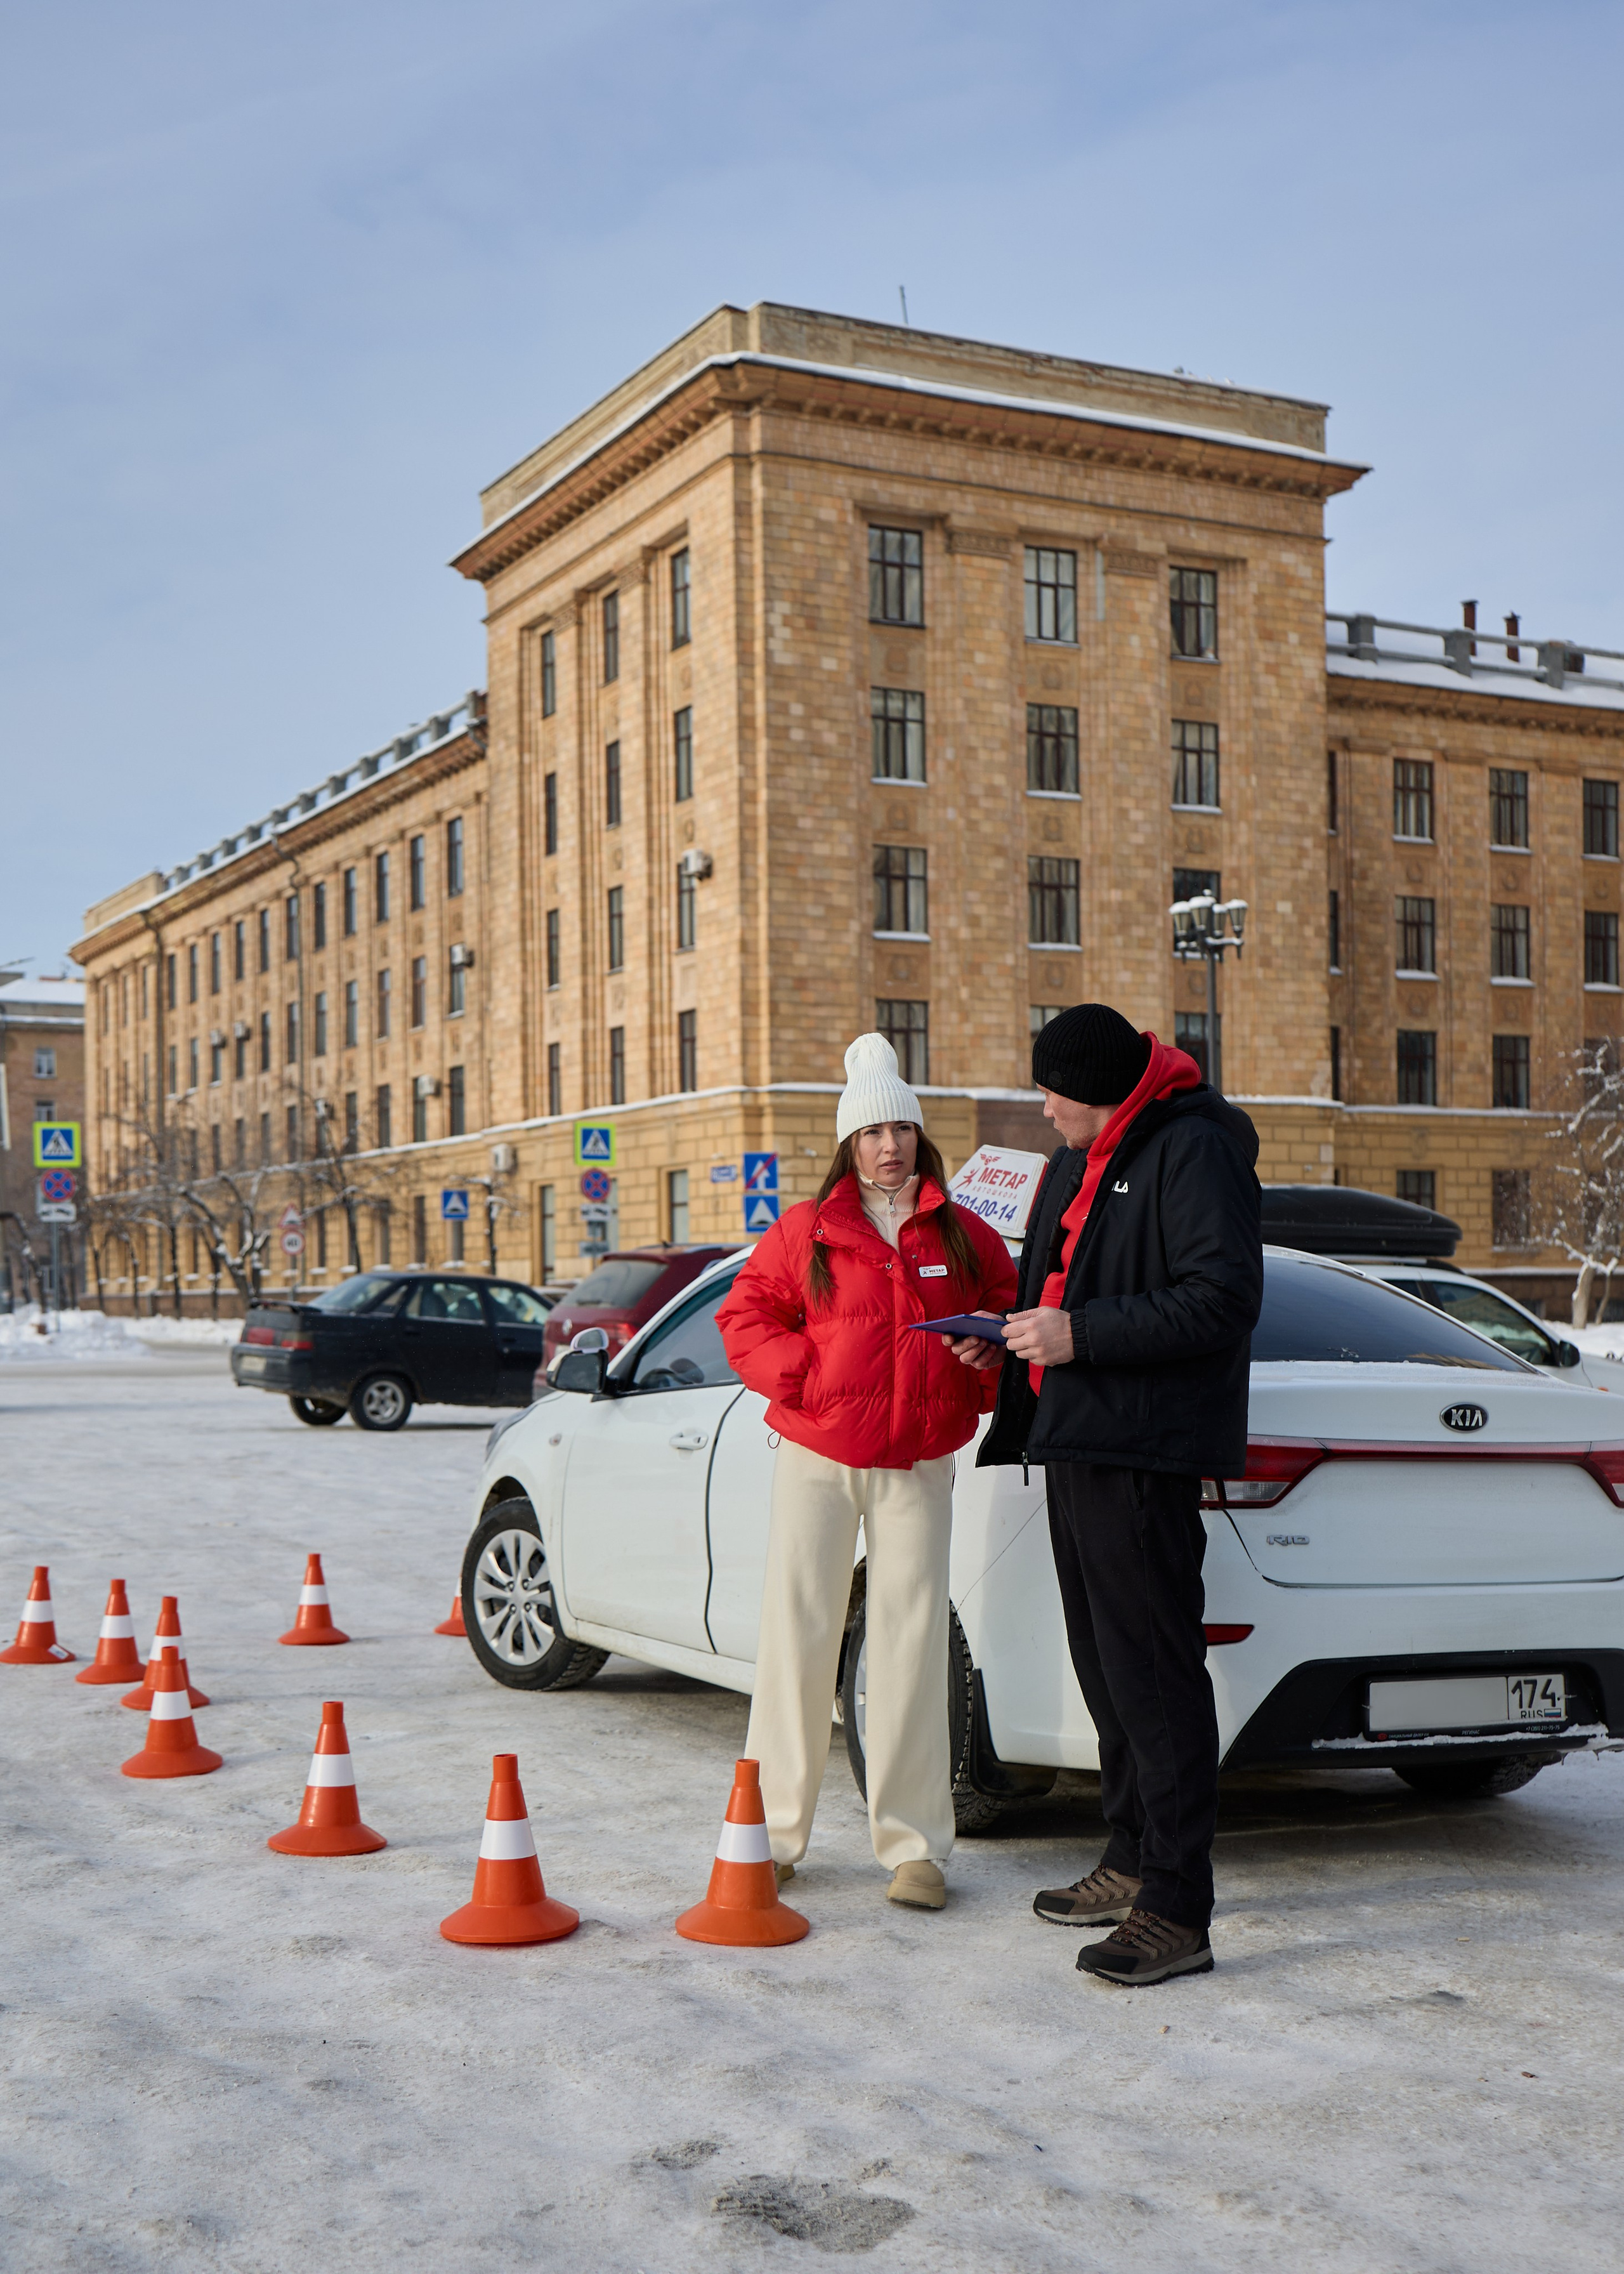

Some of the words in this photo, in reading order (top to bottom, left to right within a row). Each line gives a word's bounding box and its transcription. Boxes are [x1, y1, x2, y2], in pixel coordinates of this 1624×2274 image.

[978, 1167, 1028, 1190] МЕТАР
[972, 1185, 1018, 1200] АВТОШКОЛА
[1451, 1409, 1483, 1427] KIA
[1266, 1534, 1310, 1546] RIO
[1511, 1678, 1556, 1709] 174
[1521, 1709, 1543, 1719] RUS
